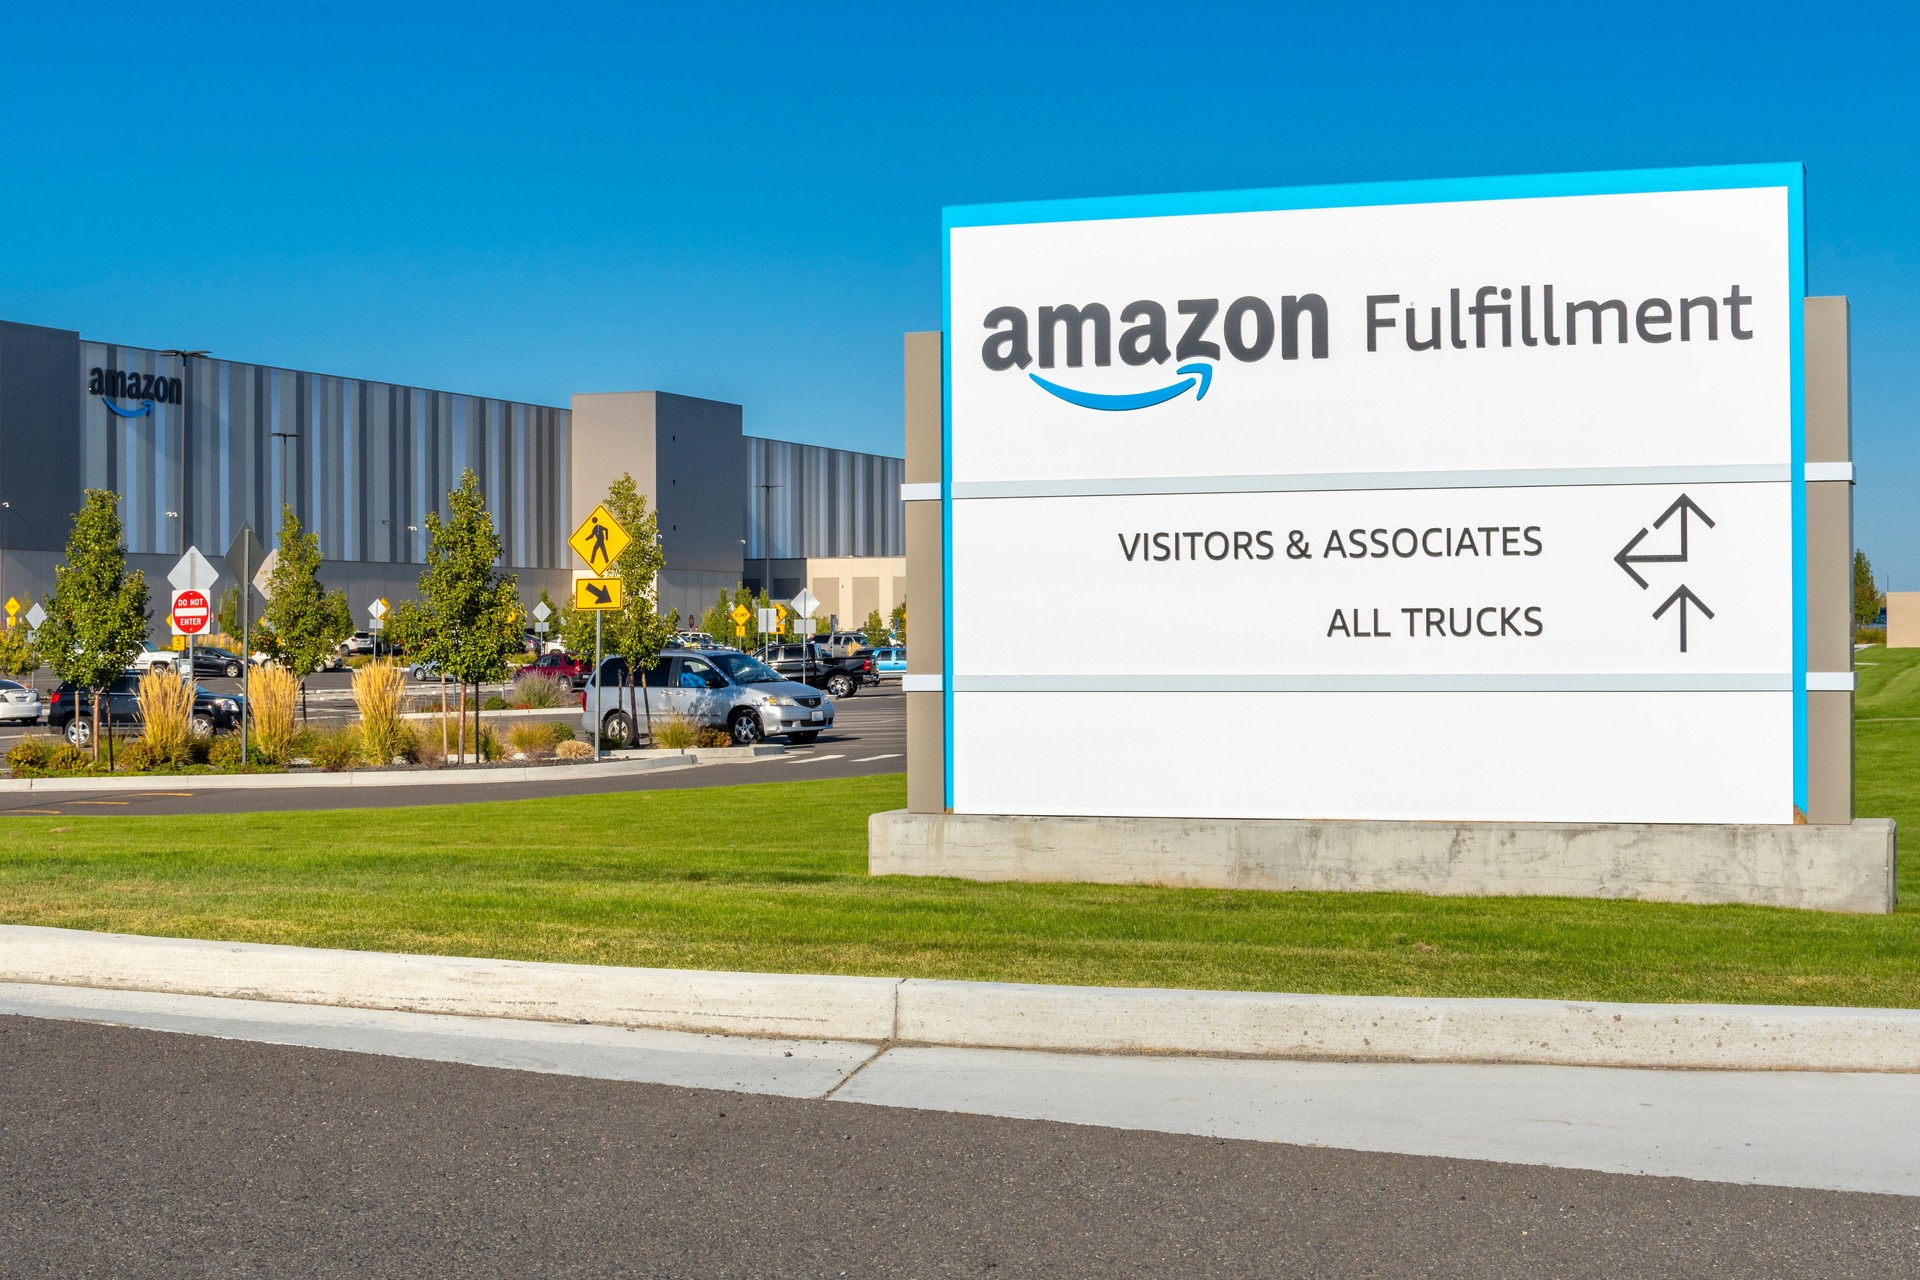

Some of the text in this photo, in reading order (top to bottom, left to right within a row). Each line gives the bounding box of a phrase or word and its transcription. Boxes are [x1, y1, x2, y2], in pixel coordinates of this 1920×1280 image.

[981, 284, 1753, 371] amazon Fulfillment
[89, 367, 182, 404] amazon
[1118, 526, 1543, 562] VISITORS & ASSOCIATES
[180, 618, 201, 626] ENTER
[1327, 606, 1543, 638] ALL TRUCKS
[177, 637, 181, 645] 5
